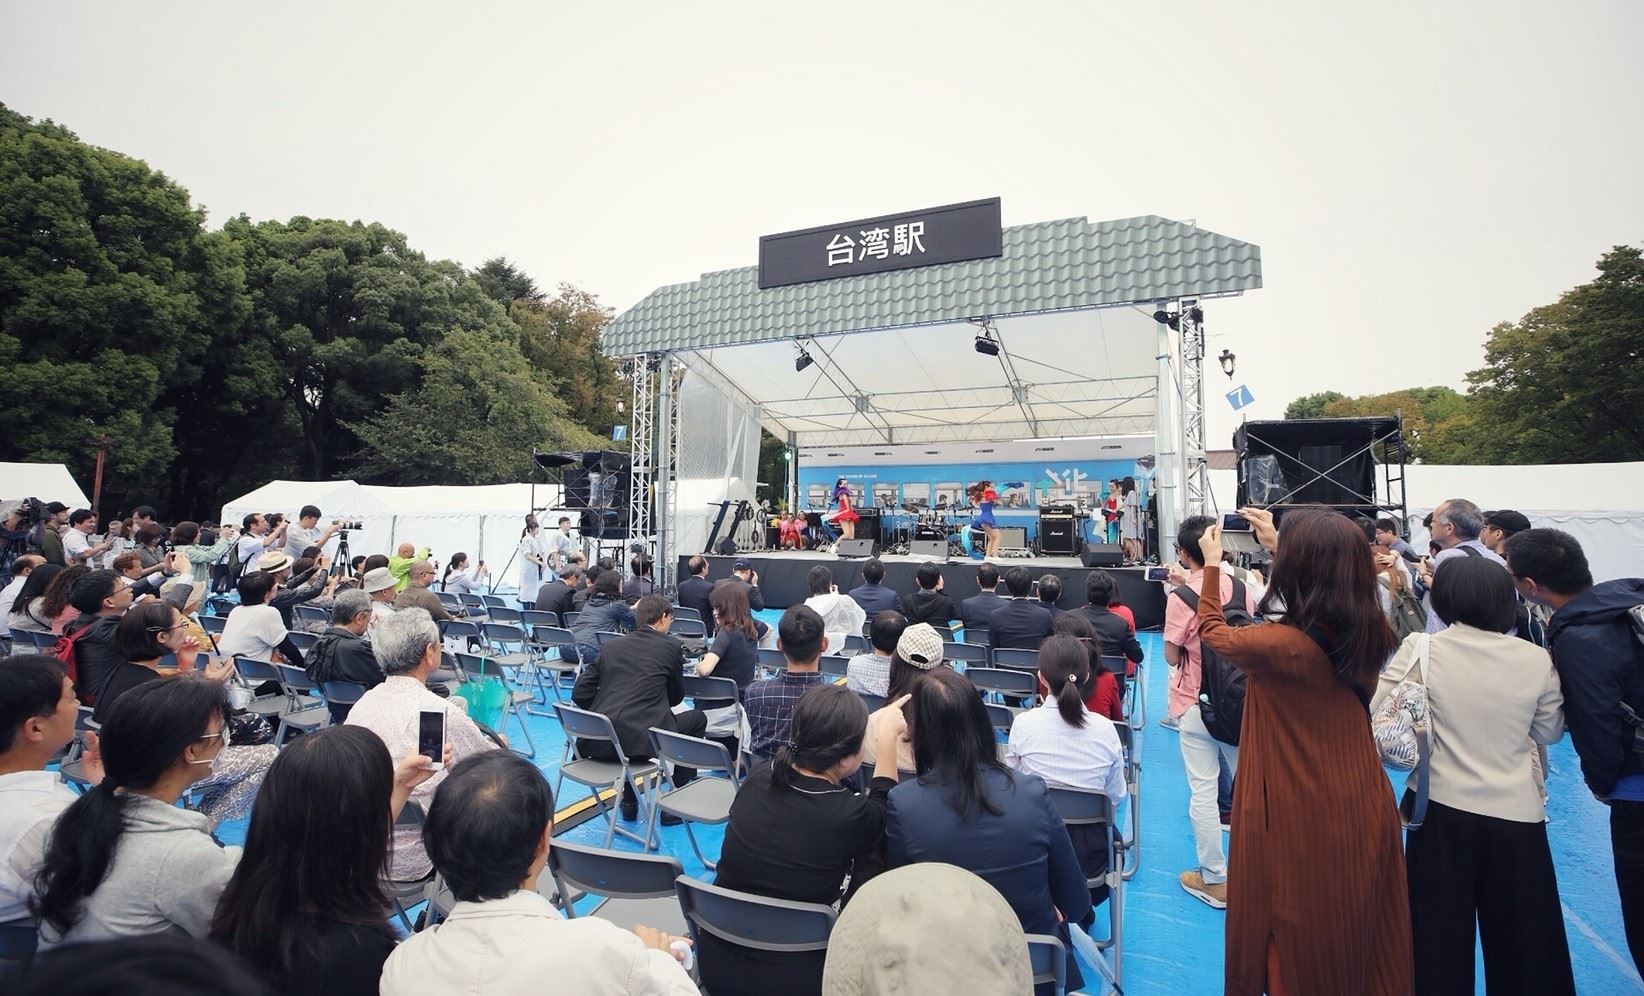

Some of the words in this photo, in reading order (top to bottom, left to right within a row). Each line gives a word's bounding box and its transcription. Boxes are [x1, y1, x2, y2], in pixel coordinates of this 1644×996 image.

[826, 221, 926, 266] 台湾駅
[1230, 387, 1244, 407] 7
[615, 426, 625, 440] 7
